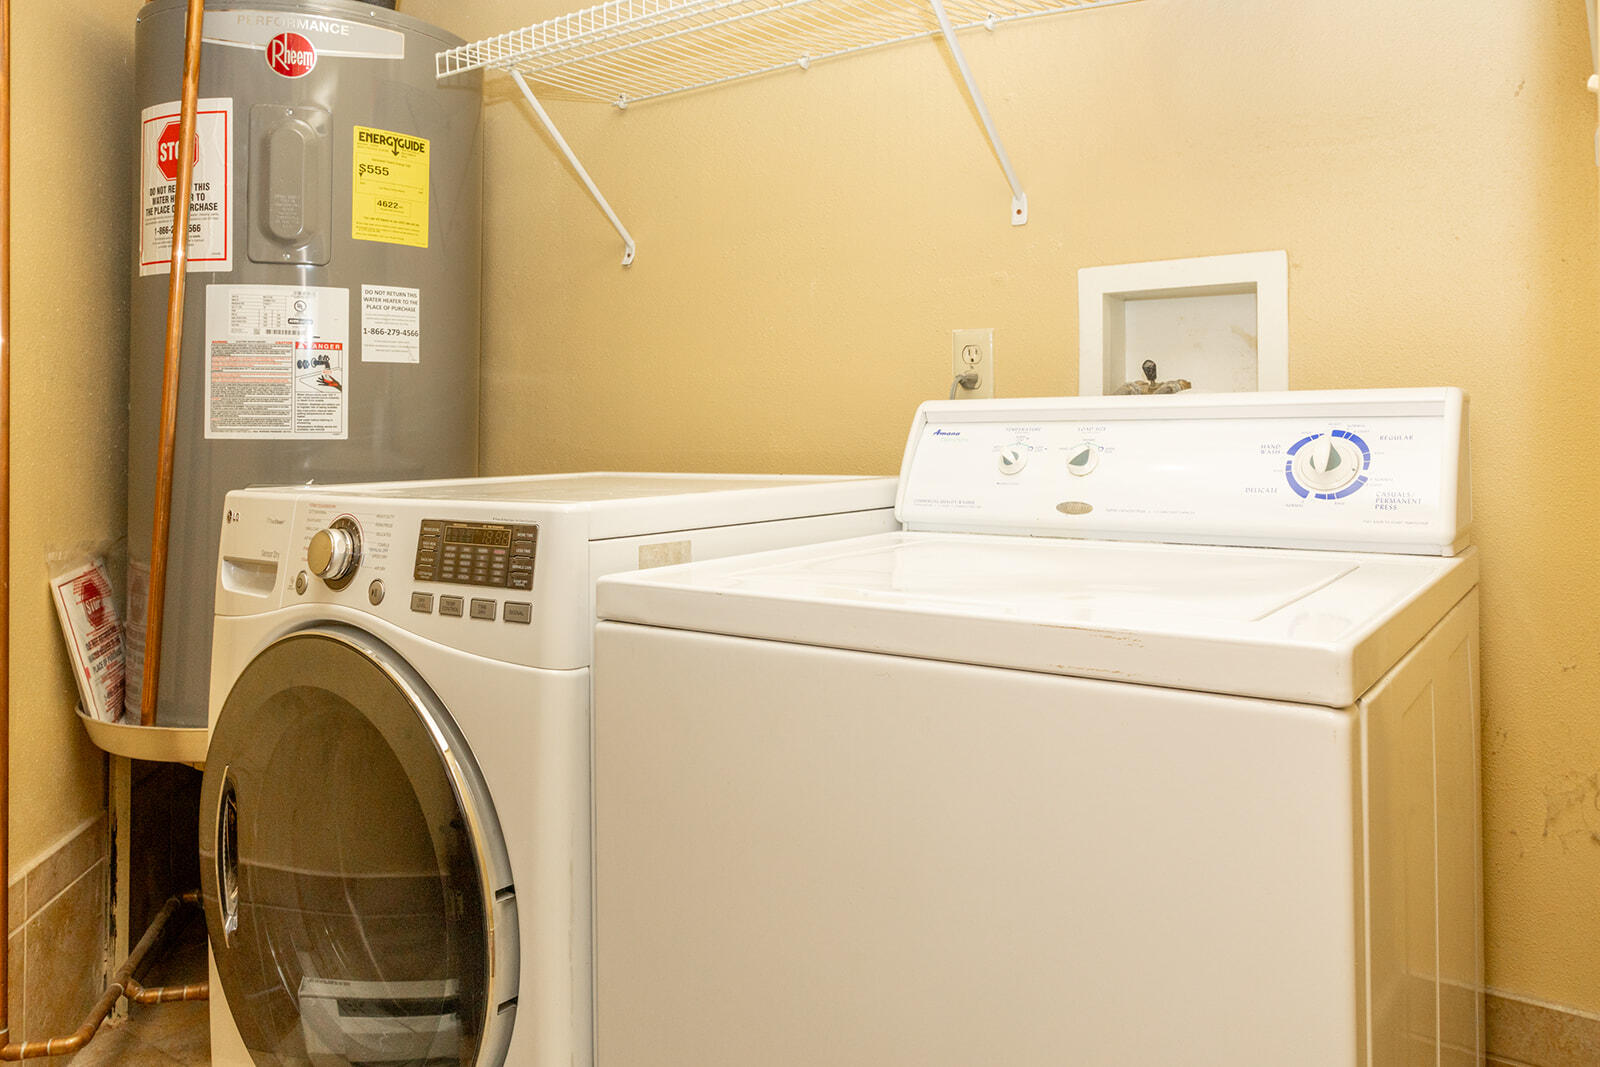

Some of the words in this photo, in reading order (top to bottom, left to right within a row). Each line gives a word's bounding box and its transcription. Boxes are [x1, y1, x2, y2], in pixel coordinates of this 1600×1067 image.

[237, 14, 350, 36] PERFORMANCE
[272, 32, 314, 71] Rheem
[358, 131, 425, 154] ENERGYGUIDE
[359, 163, 390, 176] $555
[149, 187, 156, 197] DO
[156, 185, 167, 195] NOT
[194, 182, 210, 191] THIS
[152, 195, 169, 206] WATER
[196, 192, 206, 201] TO
[376, 200, 399, 209] 4622
[145, 208, 153, 217] THE
[153, 205, 170, 216] PLACE
[189, 202, 218, 212] RCHASE
[386, 290, 407, 298] RETURN
[391, 305, 416, 313] PURCHASE
[363, 327, 419, 337] 1-866-279-4566
